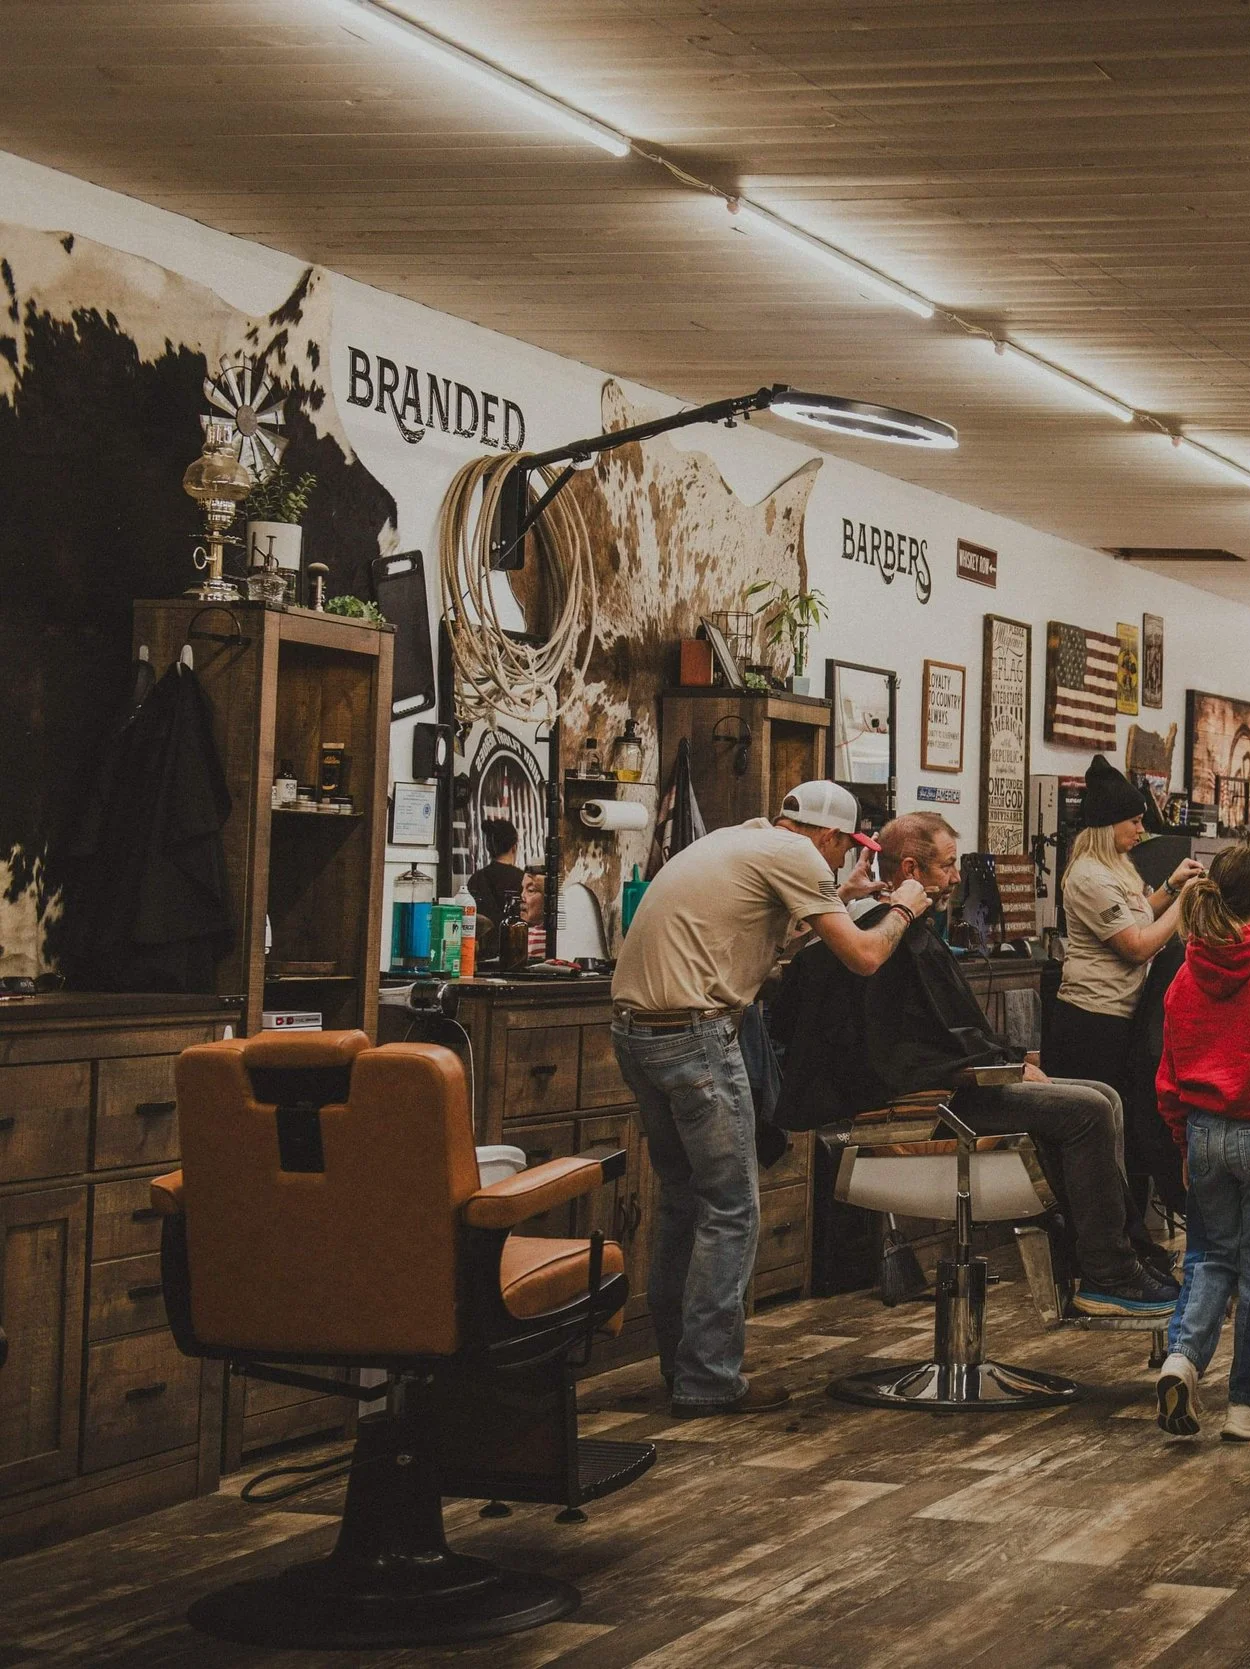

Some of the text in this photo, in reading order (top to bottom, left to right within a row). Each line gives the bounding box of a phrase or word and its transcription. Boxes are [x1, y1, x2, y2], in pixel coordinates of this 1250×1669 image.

[347, 345, 526, 453] BRANDED
[841, 517, 931, 605] BARBERS
[998, 657, 1023, 683] FLAG
[929, 673, 951, 690] LOYALTY
[936, 690, 961, 710] COUNTRY
[989, 777, 1005, 797] ONE
[1005, 790, 1023, 809] GOD
